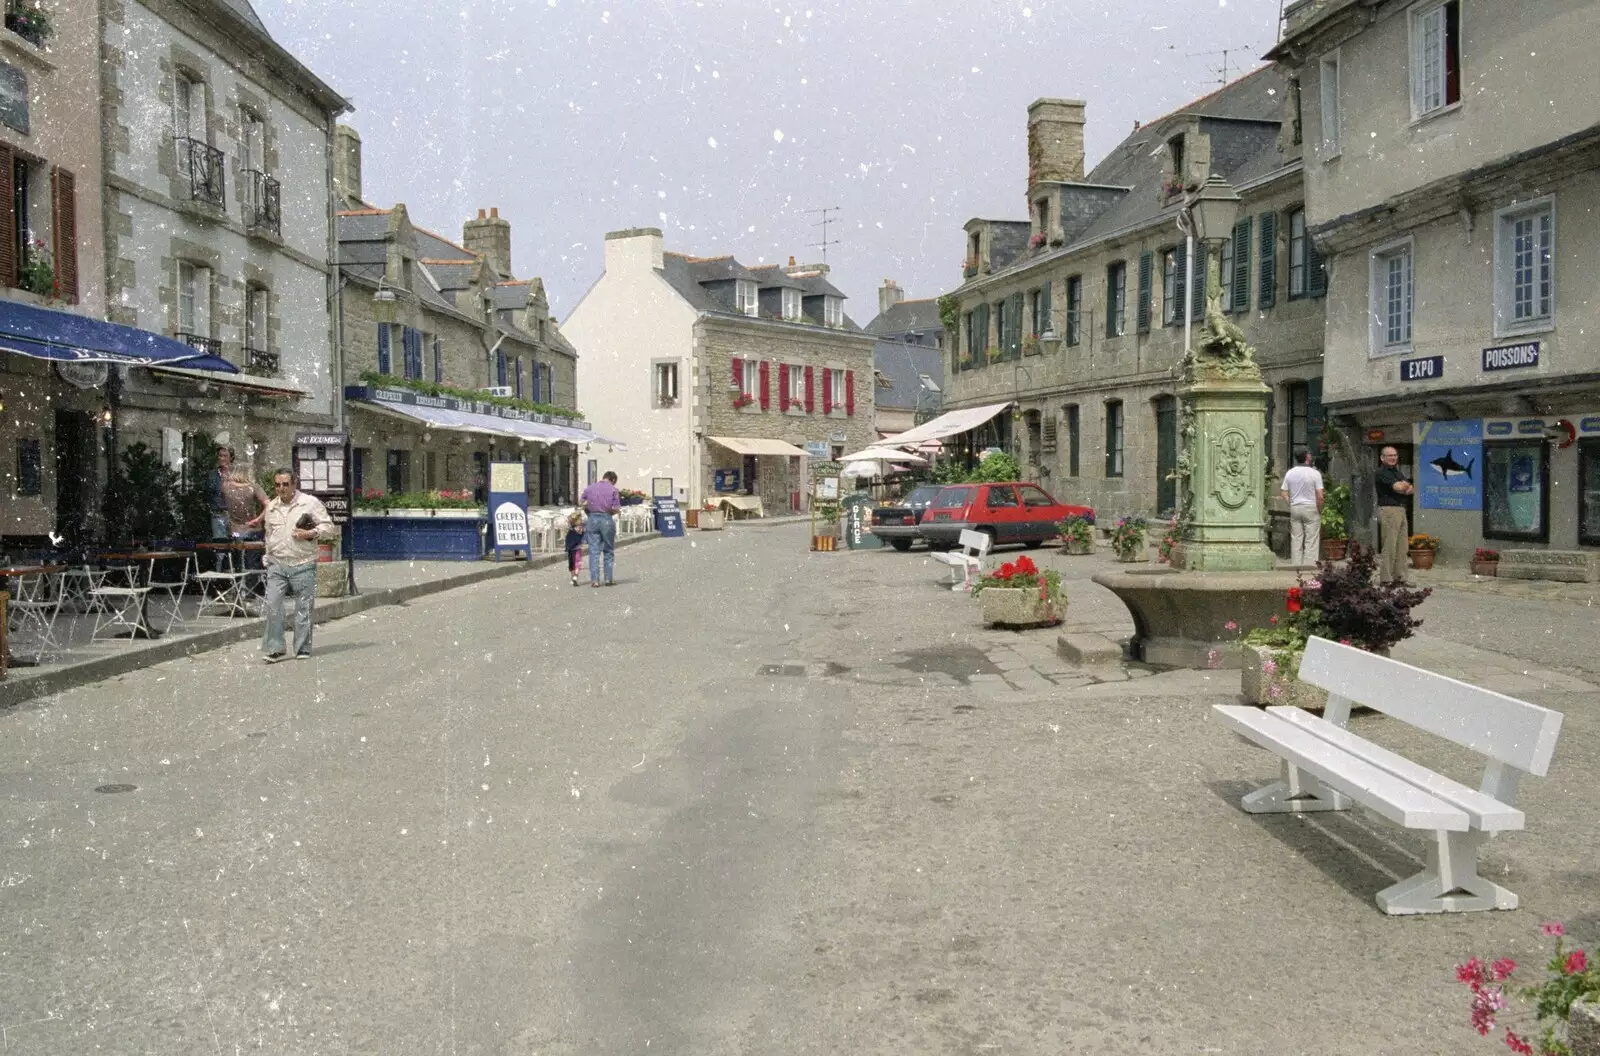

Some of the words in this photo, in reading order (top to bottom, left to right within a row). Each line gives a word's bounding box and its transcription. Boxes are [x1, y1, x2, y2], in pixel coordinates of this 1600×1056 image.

[1486, 345, 1534, 368] POISSONS
[1409, 359, 1434, 379] EXPO
[327, 500, 347, 510] OPEN
[852, 505, 861, 544] GLACE
[498, 533, 508, 541] DE
[510, 533, 526, 541] MER
